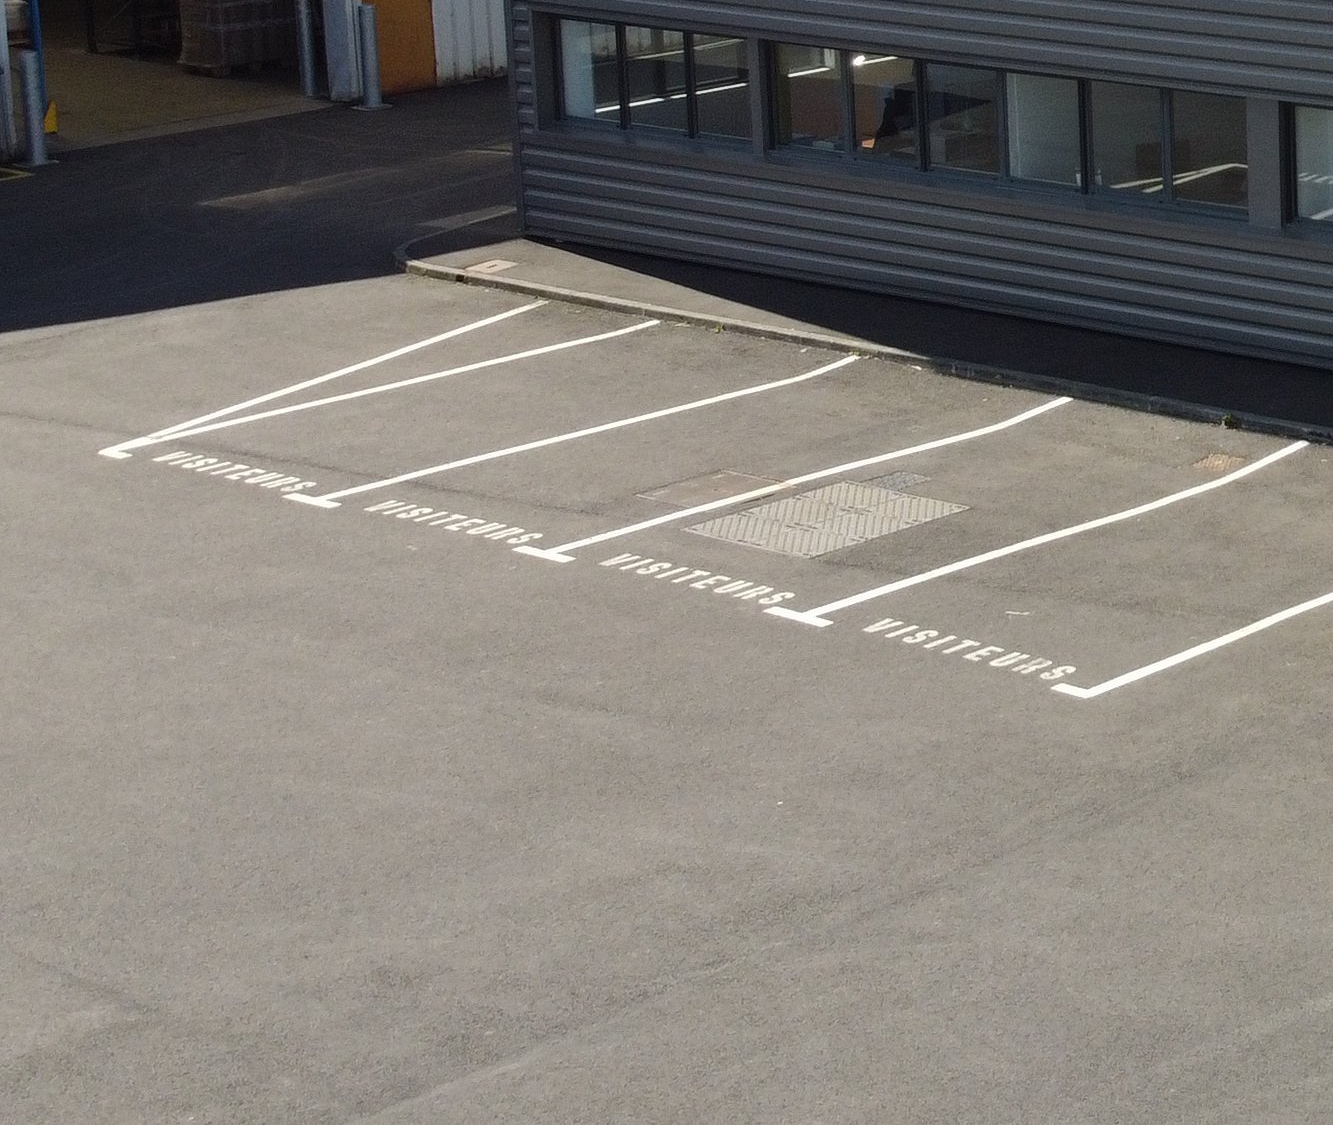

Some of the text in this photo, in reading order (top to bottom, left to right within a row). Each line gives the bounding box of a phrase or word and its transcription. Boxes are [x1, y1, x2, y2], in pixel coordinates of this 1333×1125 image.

[152, 450, 317, 492] VISITEURS
[363, 499, 544, 544] VISITEURS
[599, 553, 796, 605] VISITEURS
[861, 617, 1077, 680] VISITEURS
